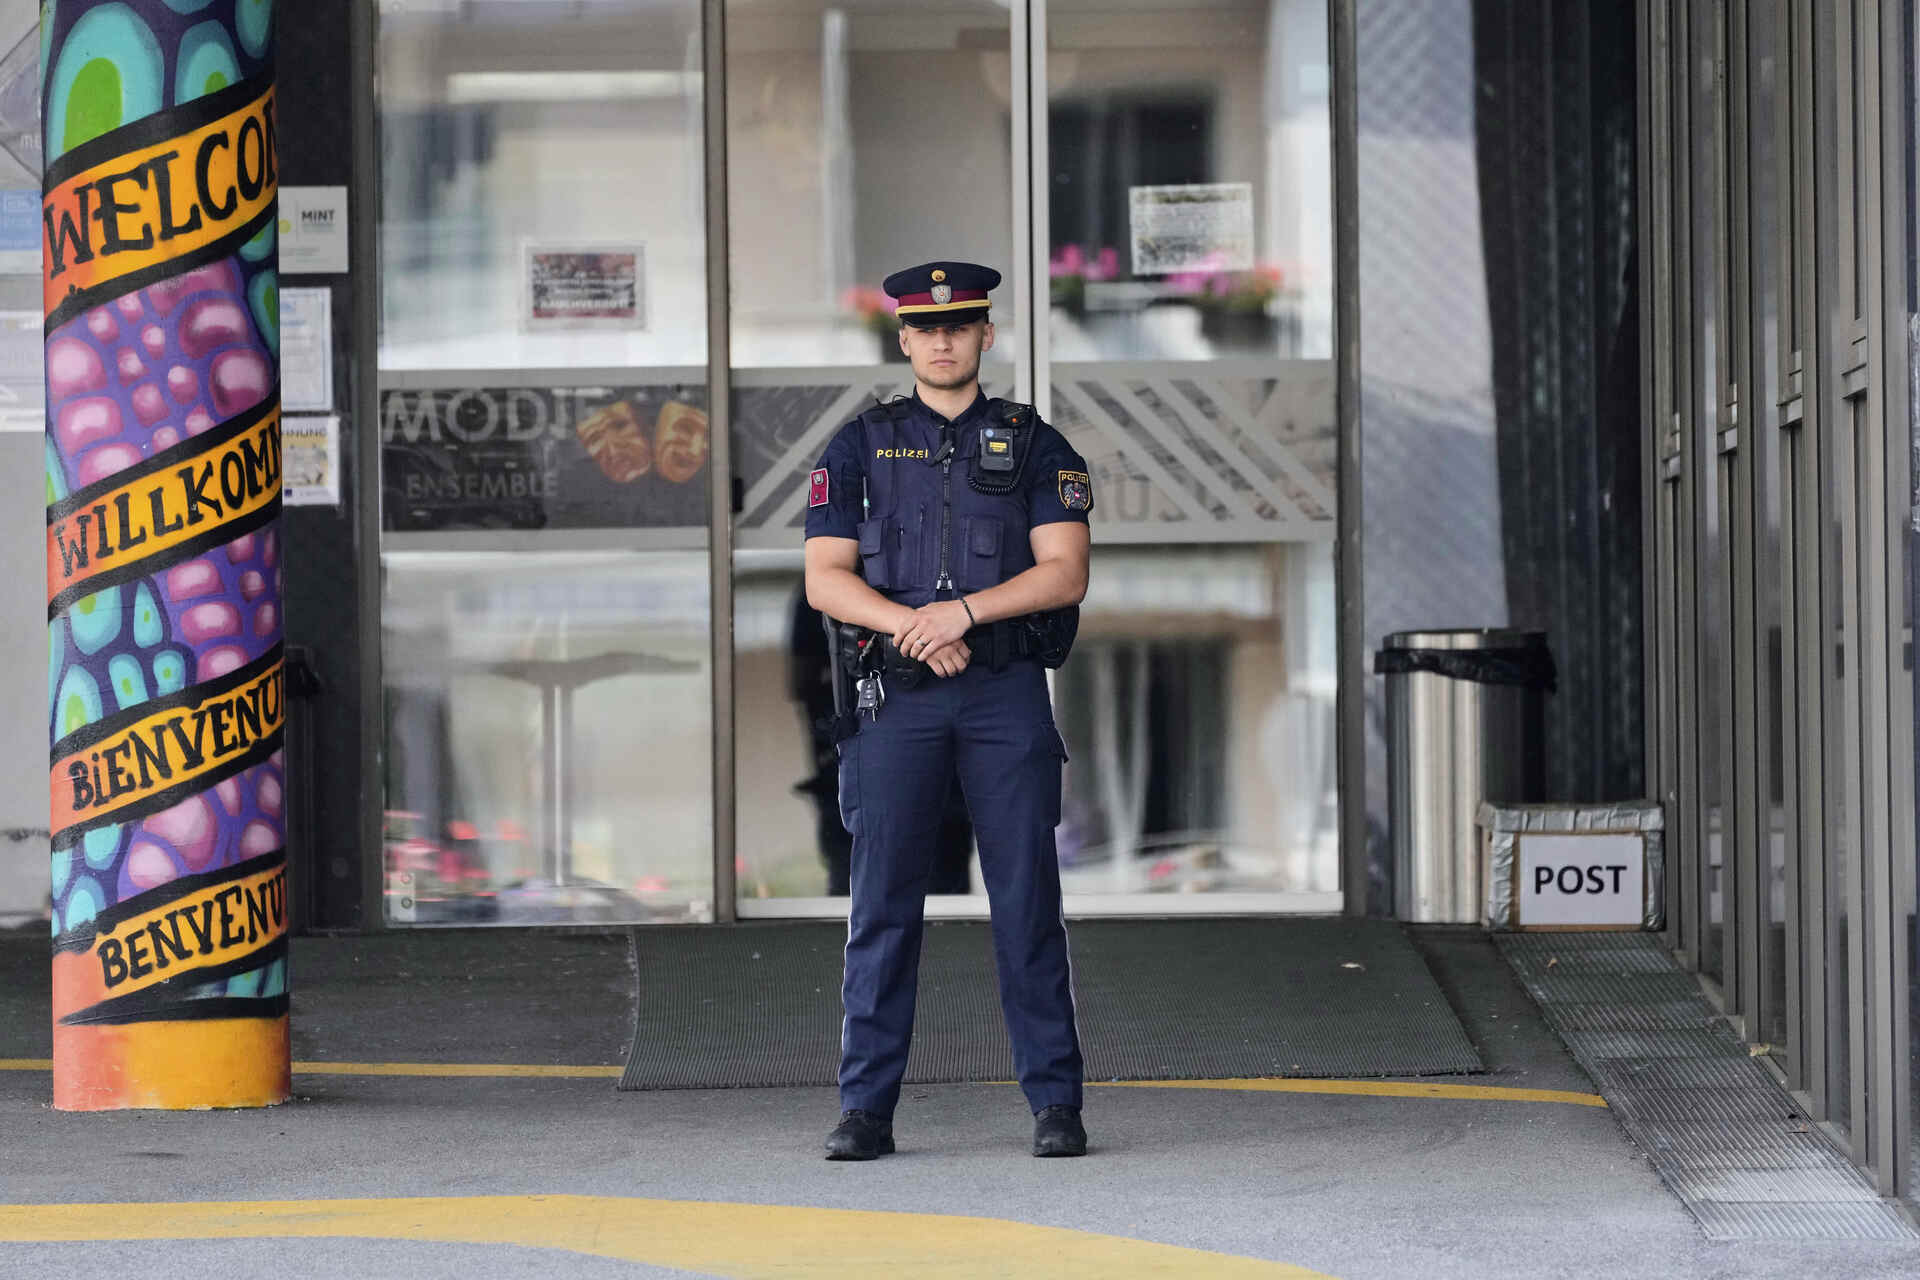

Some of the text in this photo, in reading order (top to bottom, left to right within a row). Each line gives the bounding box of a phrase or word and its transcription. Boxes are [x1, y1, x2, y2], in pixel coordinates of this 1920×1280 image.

[301, 207, 336, 222] MINT
[876, 448, 929, 459] POLIZEI
[405, 472, 559, 500] ENSEMBLE
[67, 668, 284, 811] BiENVENU
[1534, 865, 1627, 895] POST
